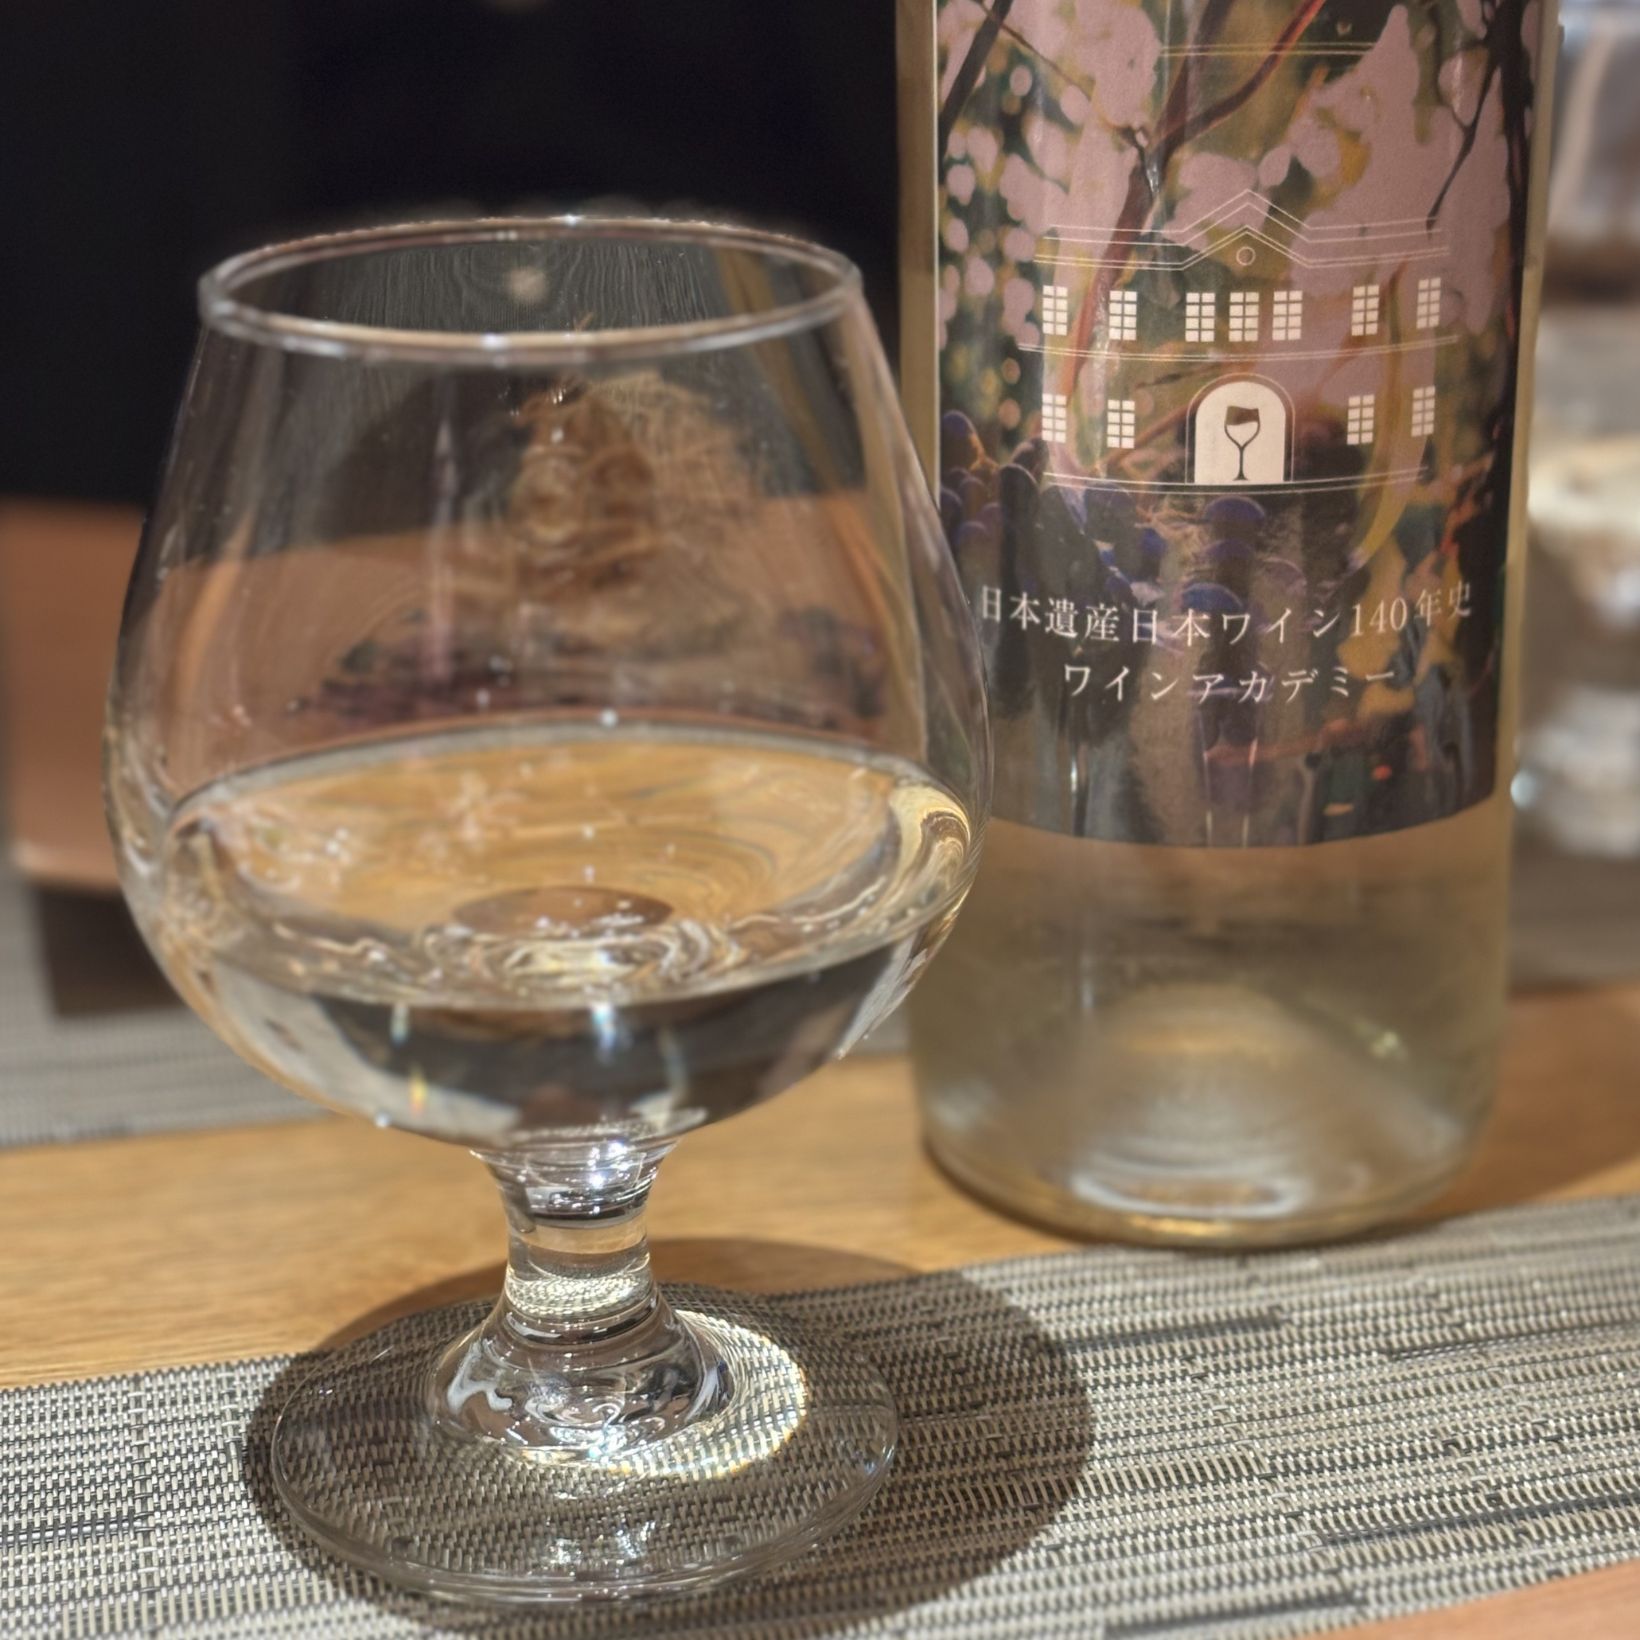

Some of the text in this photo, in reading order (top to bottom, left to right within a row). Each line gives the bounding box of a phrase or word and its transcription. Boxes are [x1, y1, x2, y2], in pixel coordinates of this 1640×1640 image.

[980, 583, 1472, 646] 日本遺産日本ワイン140年史
[1064, 665, 1396, 703] ワインアカデミー
